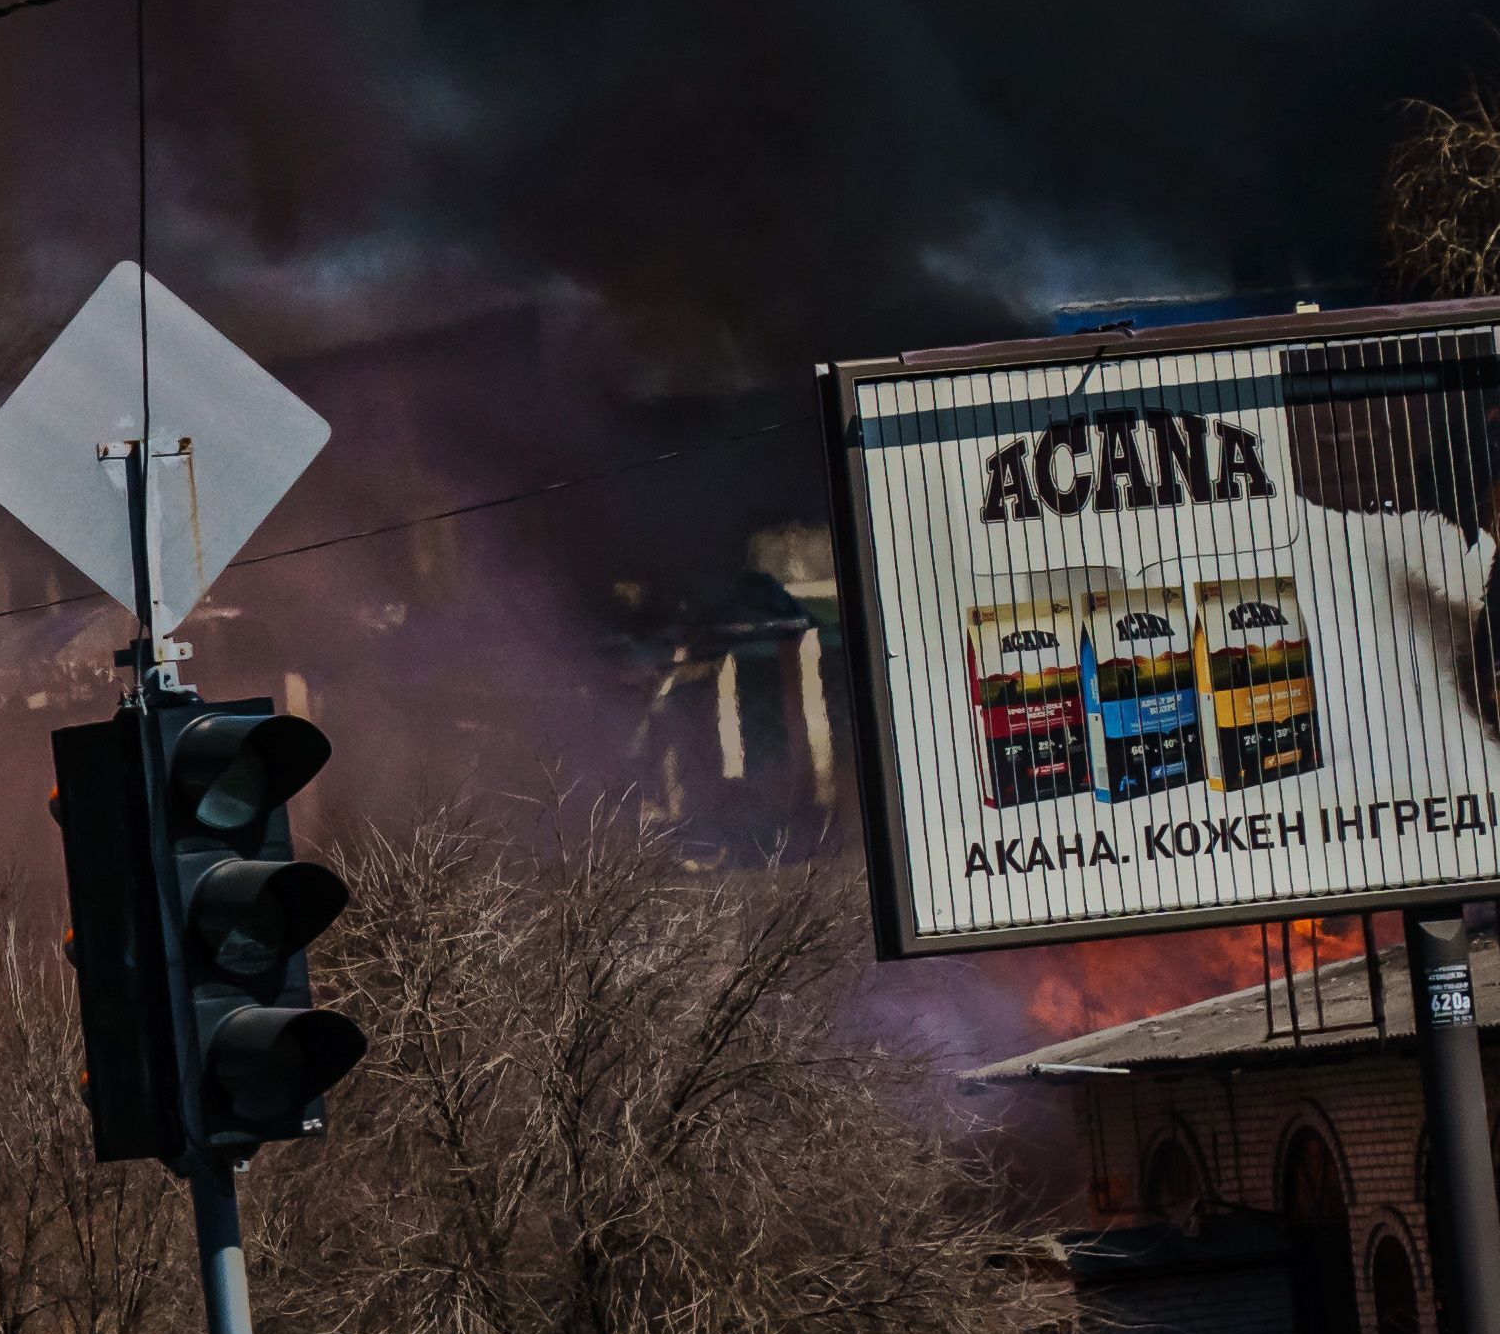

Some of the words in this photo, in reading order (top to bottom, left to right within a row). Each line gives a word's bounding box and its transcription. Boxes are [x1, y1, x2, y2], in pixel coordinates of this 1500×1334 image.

[981, 407, 1276, 522] ACANA
[1116, 613, 1175, 641] ACANA
[1228, 602, 1288, 630] ACANA
[1002, 630, 1059, 653] ACANA
[965, 830, 1130, 878] АКАНА.
[1144, 810, 1305, 860] КОЖЕН
